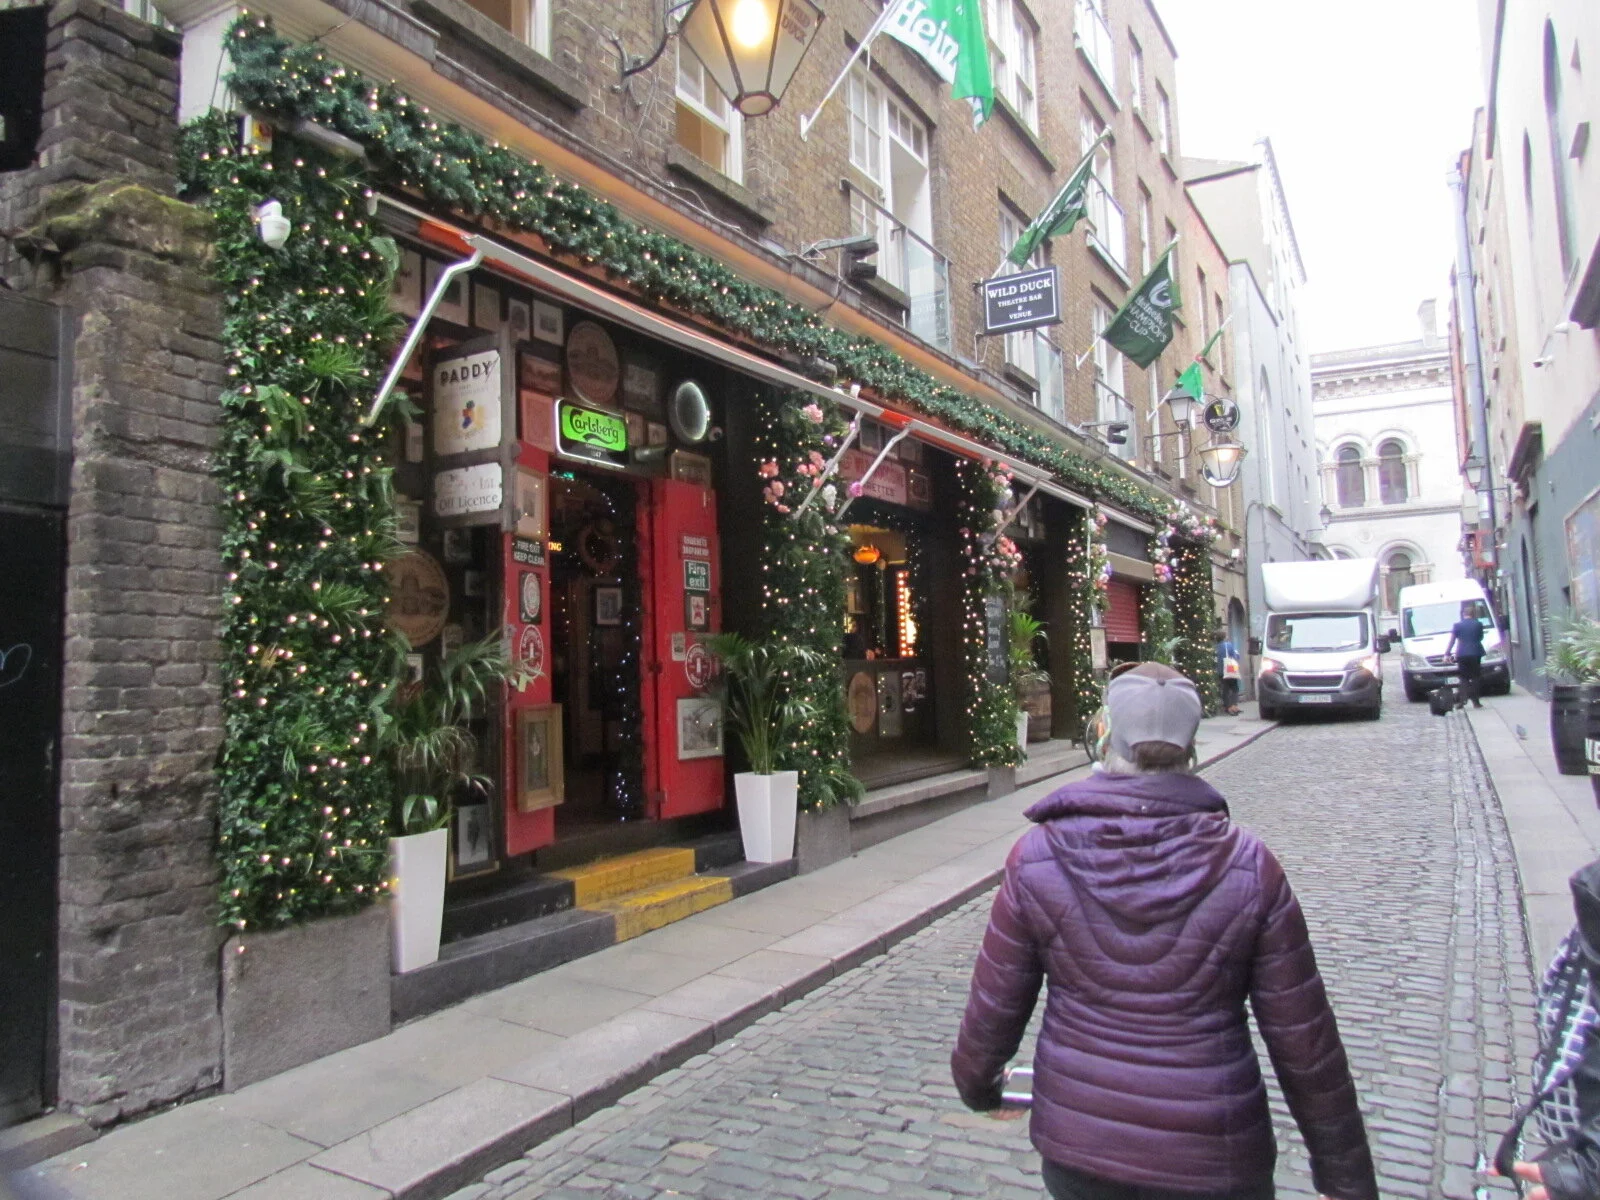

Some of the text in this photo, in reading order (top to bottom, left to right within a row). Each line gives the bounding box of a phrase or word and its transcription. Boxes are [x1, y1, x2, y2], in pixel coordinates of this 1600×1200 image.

[780, 13, 807, 46] DUCK
[988, 278, 1052, 299] WILD DUCK
[998, 293, 1043, 308] THEATRE BAR
[1009, 310, 1032, 320] VENUE
[1129, 320, 1149, 336] CUP
[440, 361, 492, 387] PADDY
[569, 408, 619, 445] Carlsberg
[458, 494, 499, 509] Licence
[688, 562, 706, 576] Fire
[689, 575, 706, 588] exit
